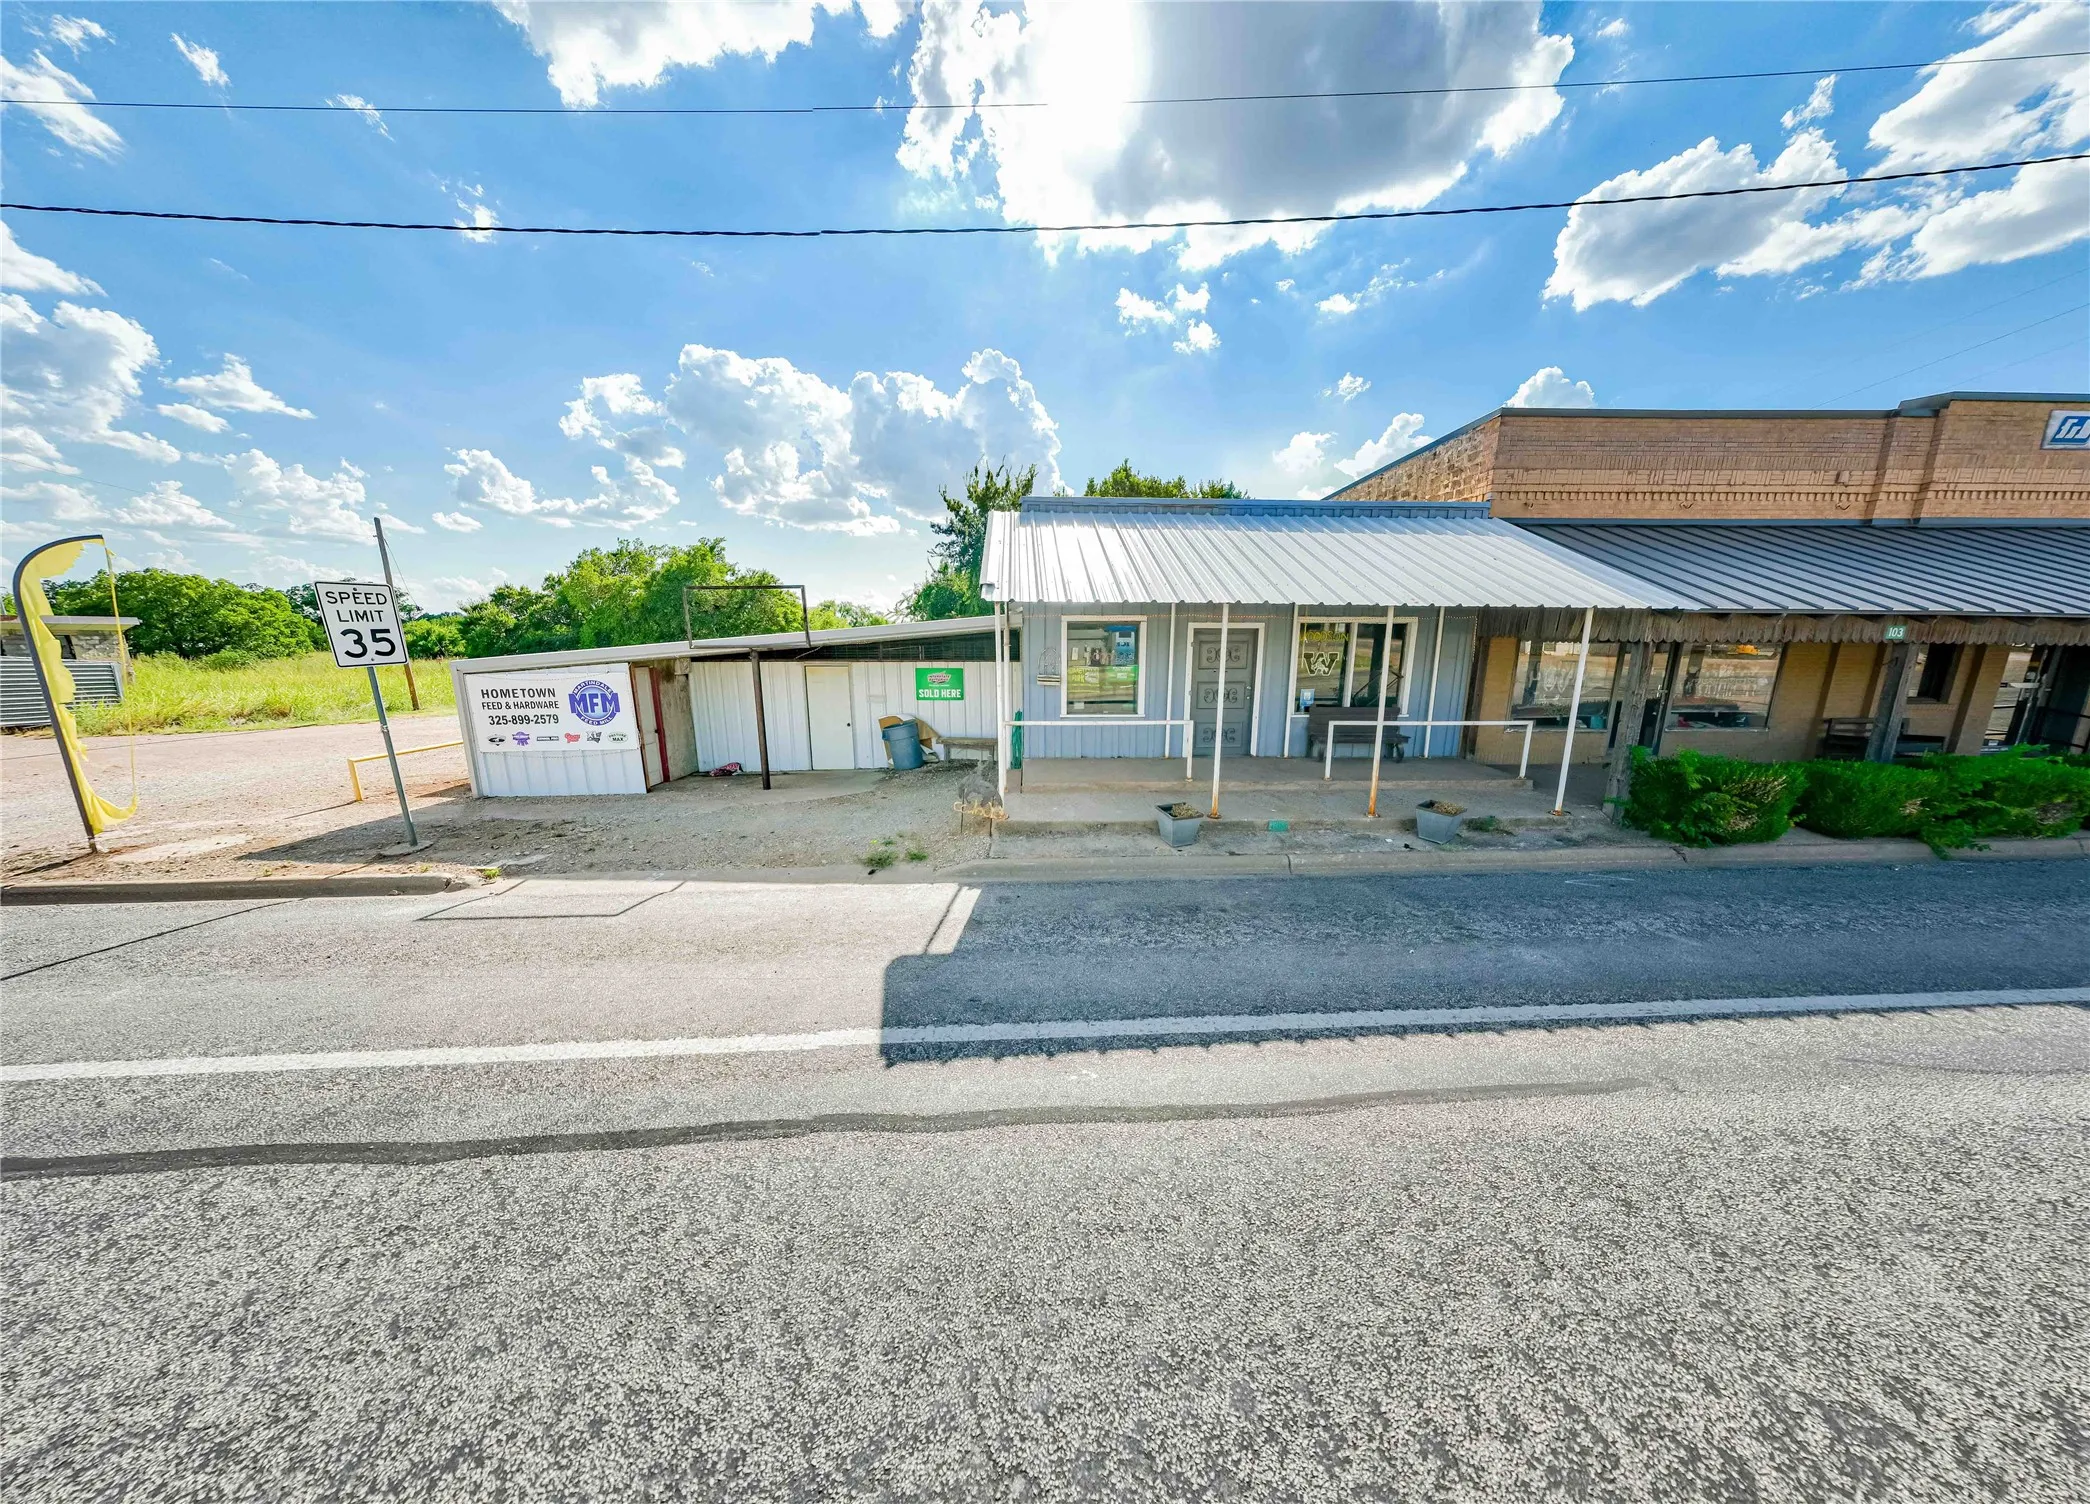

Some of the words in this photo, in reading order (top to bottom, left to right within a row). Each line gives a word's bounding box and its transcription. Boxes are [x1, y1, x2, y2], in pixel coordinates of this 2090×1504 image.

[325, 591, 387, 605] SPEED
[336, 610, 383, 622] LIMIT
[1888, 627, 1904, 637] 103
[340, 628, 396, 658] 35
[480, 688, 556, 699] HOMETOWN
[919, 688, 939, 698] SOLD
[941, 688, 961, 698] HERE
[481, 701, 503, 710] FEED
[504, 701, 512, 710] &
[513, 700, 560, 710] HARDWARE
[568, 692, 621, 714] MFM
[488, 713, 559, 726] 325-899-2579
